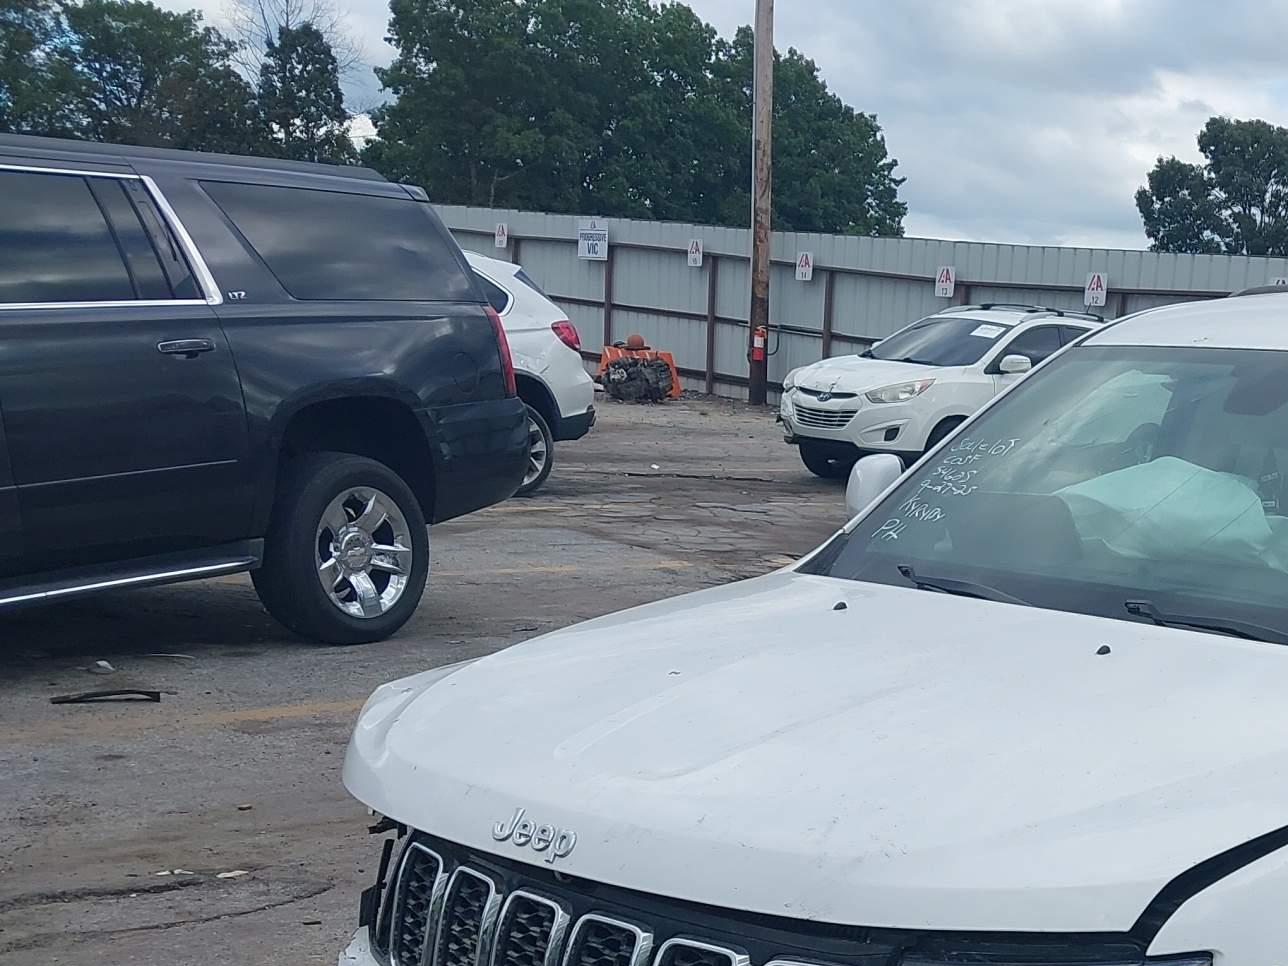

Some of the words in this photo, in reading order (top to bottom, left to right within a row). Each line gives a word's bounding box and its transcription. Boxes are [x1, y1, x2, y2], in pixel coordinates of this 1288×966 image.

[587, 242, 599, 255] VIC
[1091, 296, 1099, 304] 12
[492, 807, 578, 864] Jeep
